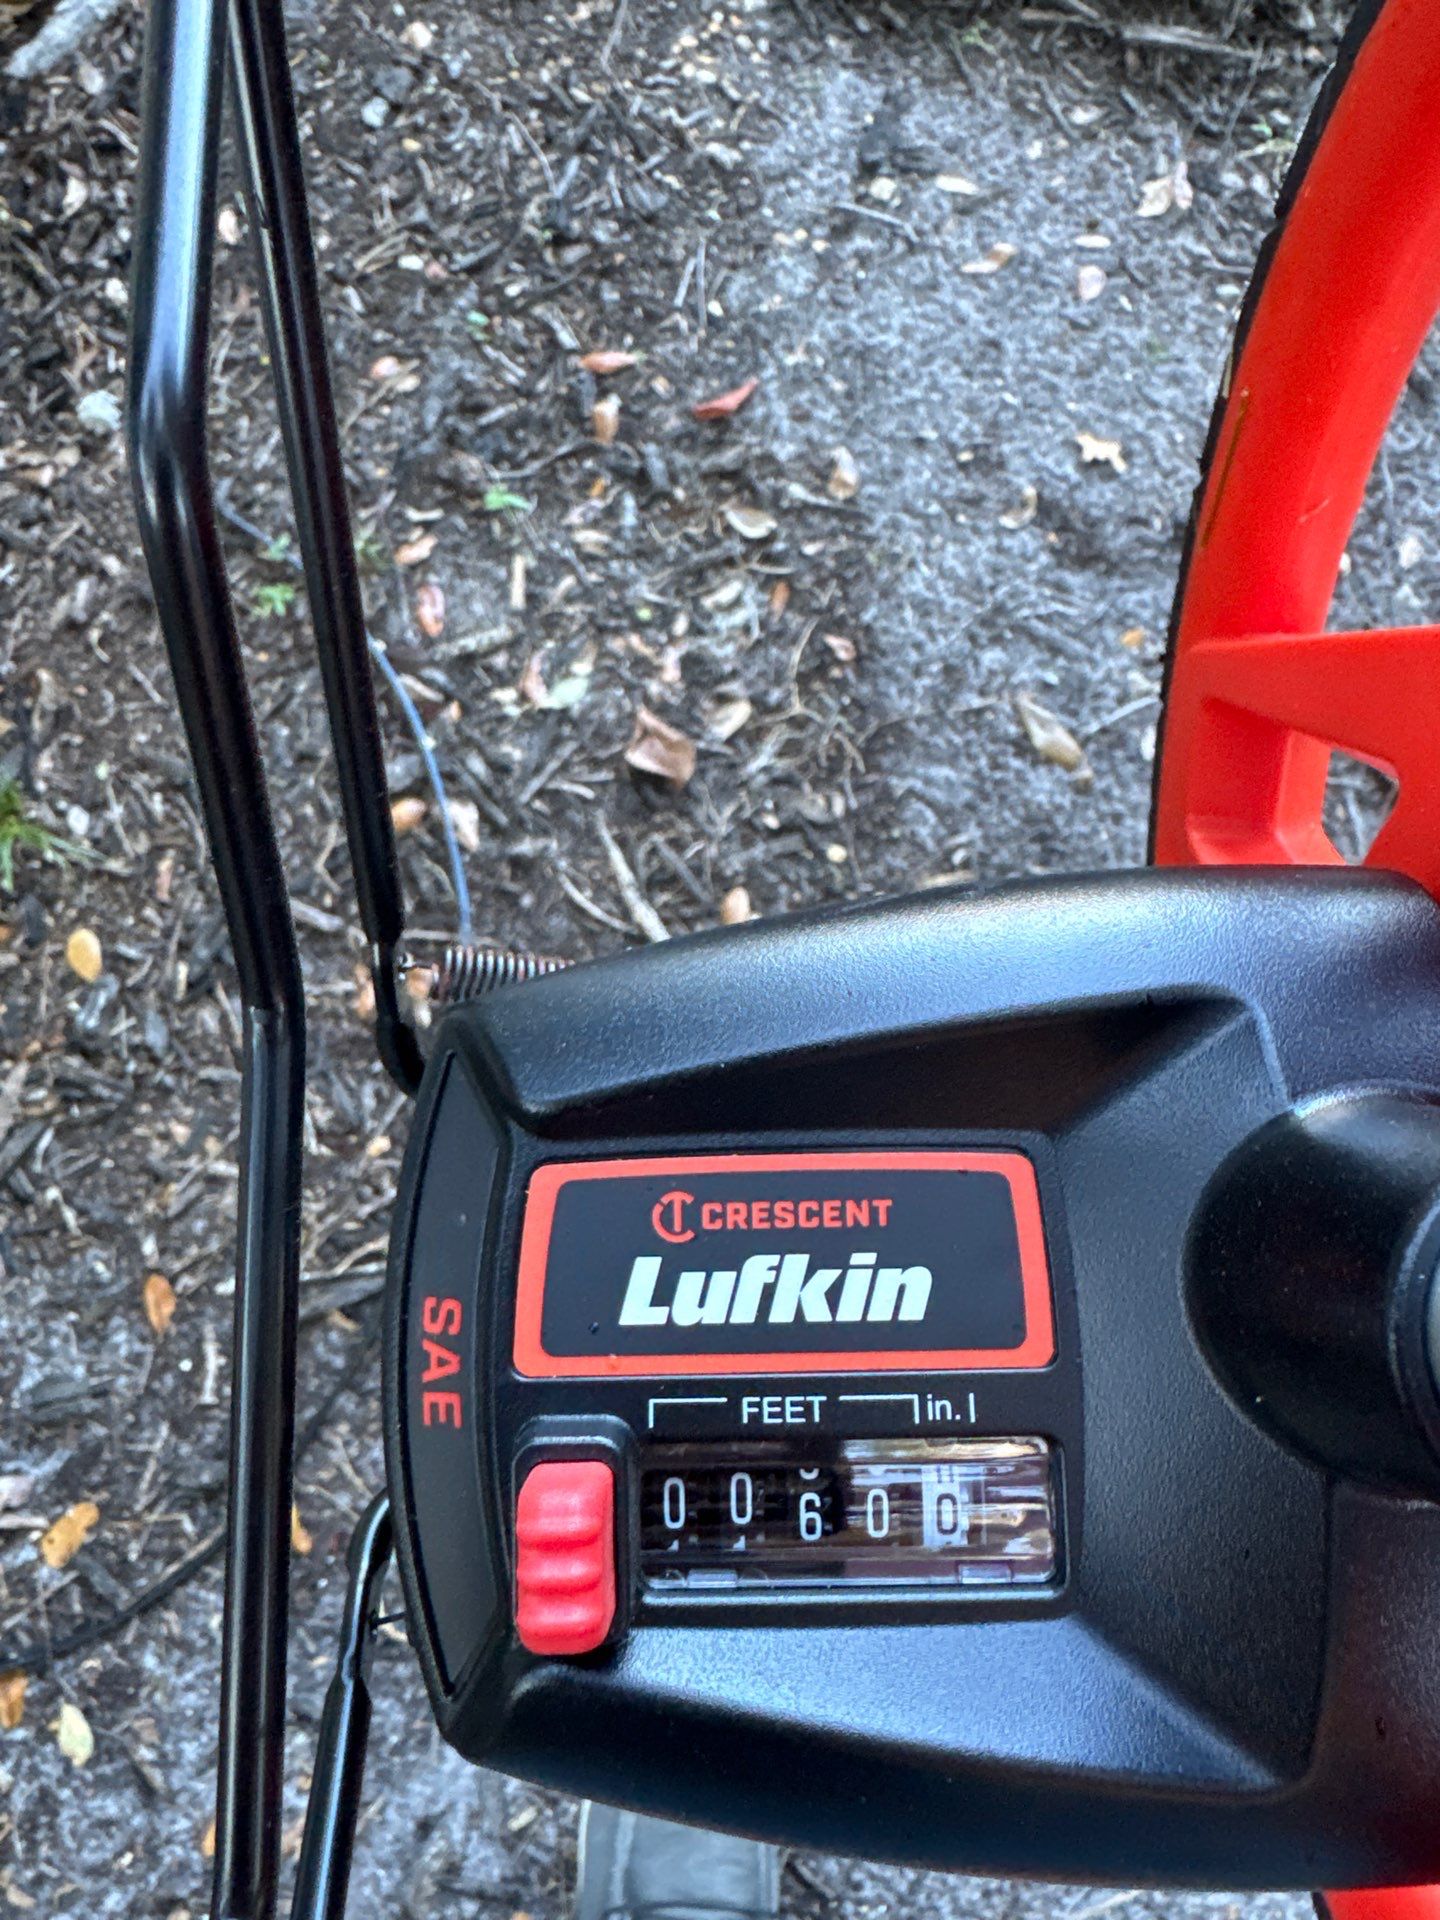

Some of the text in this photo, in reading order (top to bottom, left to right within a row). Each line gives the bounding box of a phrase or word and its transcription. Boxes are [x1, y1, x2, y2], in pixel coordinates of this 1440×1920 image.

[701, 1198, 893, 1231] CRESCENT
[618, 1252, 933, 1326] Lufkin
[420, 1295, 462, 1430] SAE
[741, 1394, 962, 1424] FEET in.
